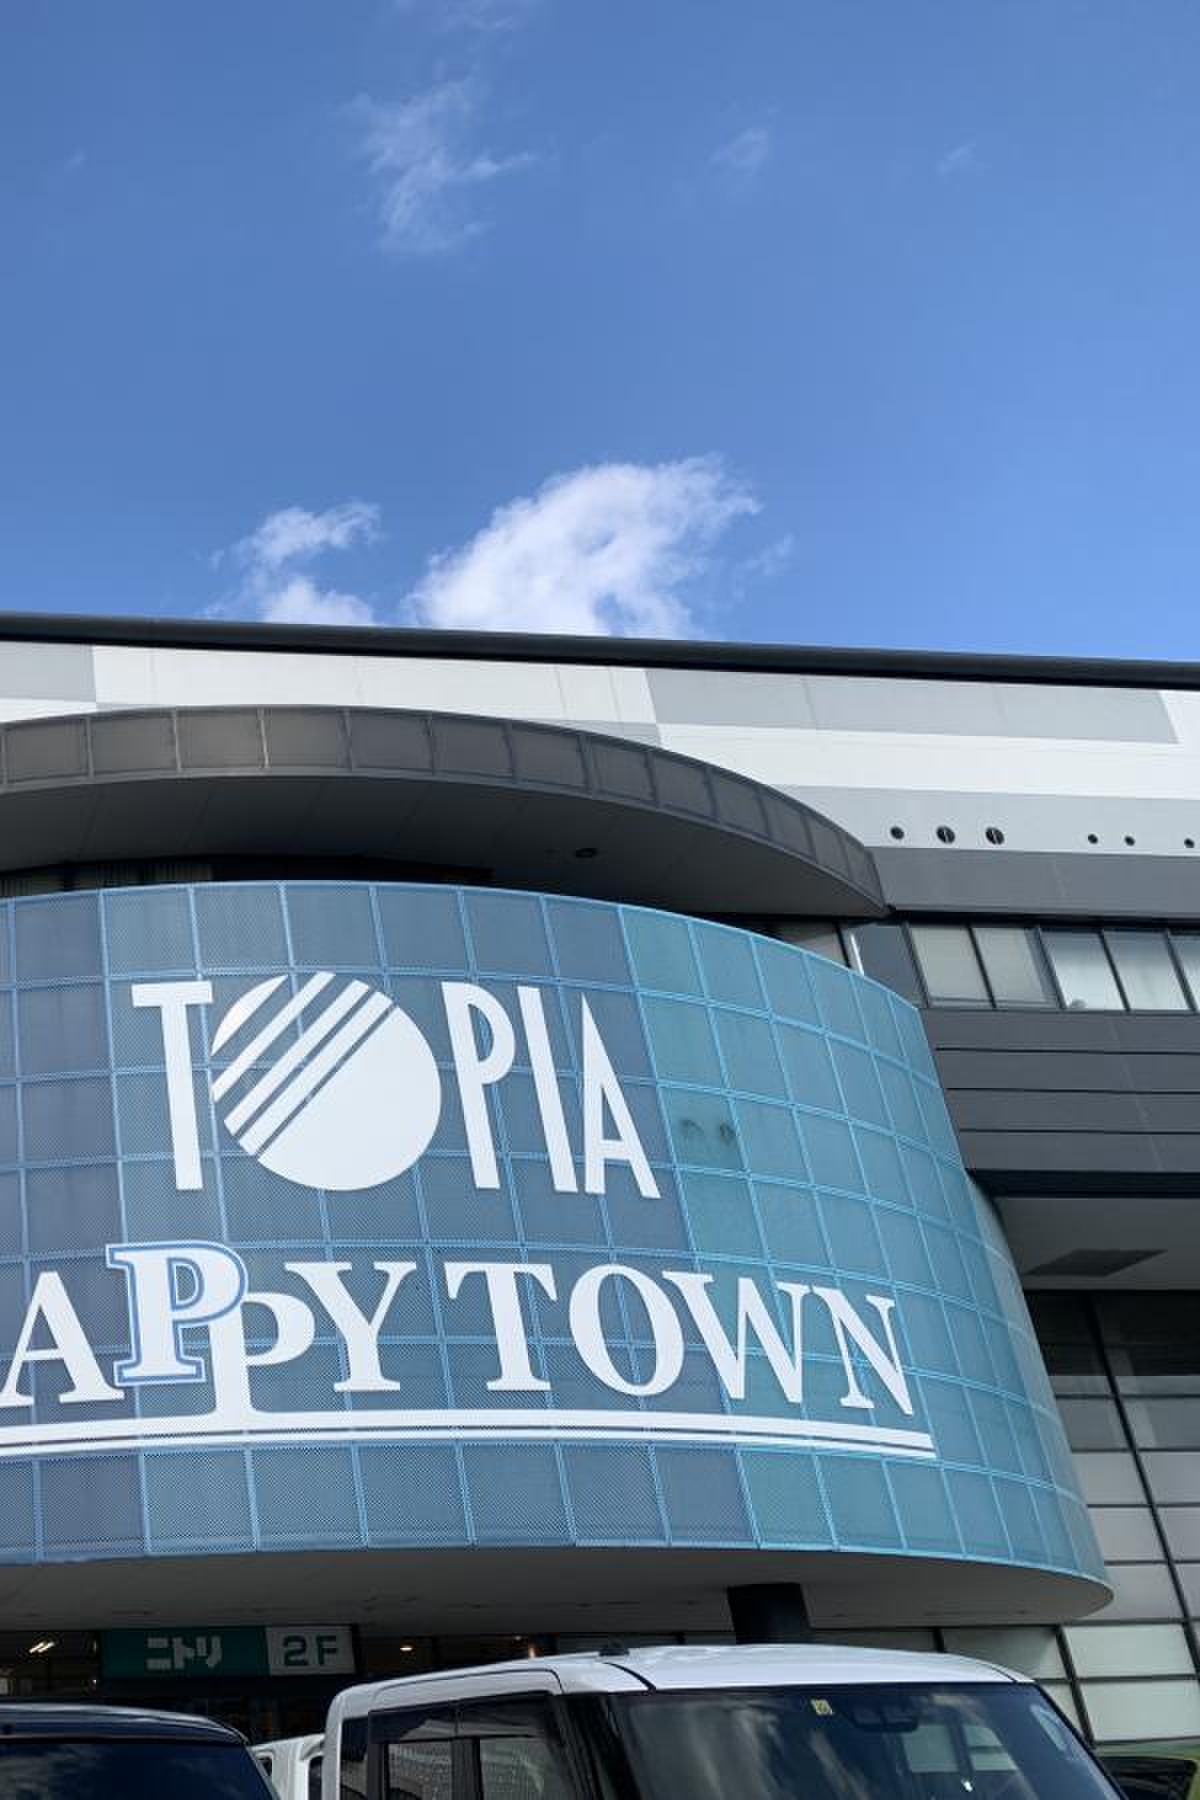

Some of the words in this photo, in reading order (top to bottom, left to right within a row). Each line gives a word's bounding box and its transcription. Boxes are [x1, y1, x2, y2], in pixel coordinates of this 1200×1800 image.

[132, 971, 661, 1199] TOPIA
[444, 1260, 914, 1416] TOWN
[146, 1635, 222, 1671] ニトリ
[282, 1634, 337, 1667] 2F
